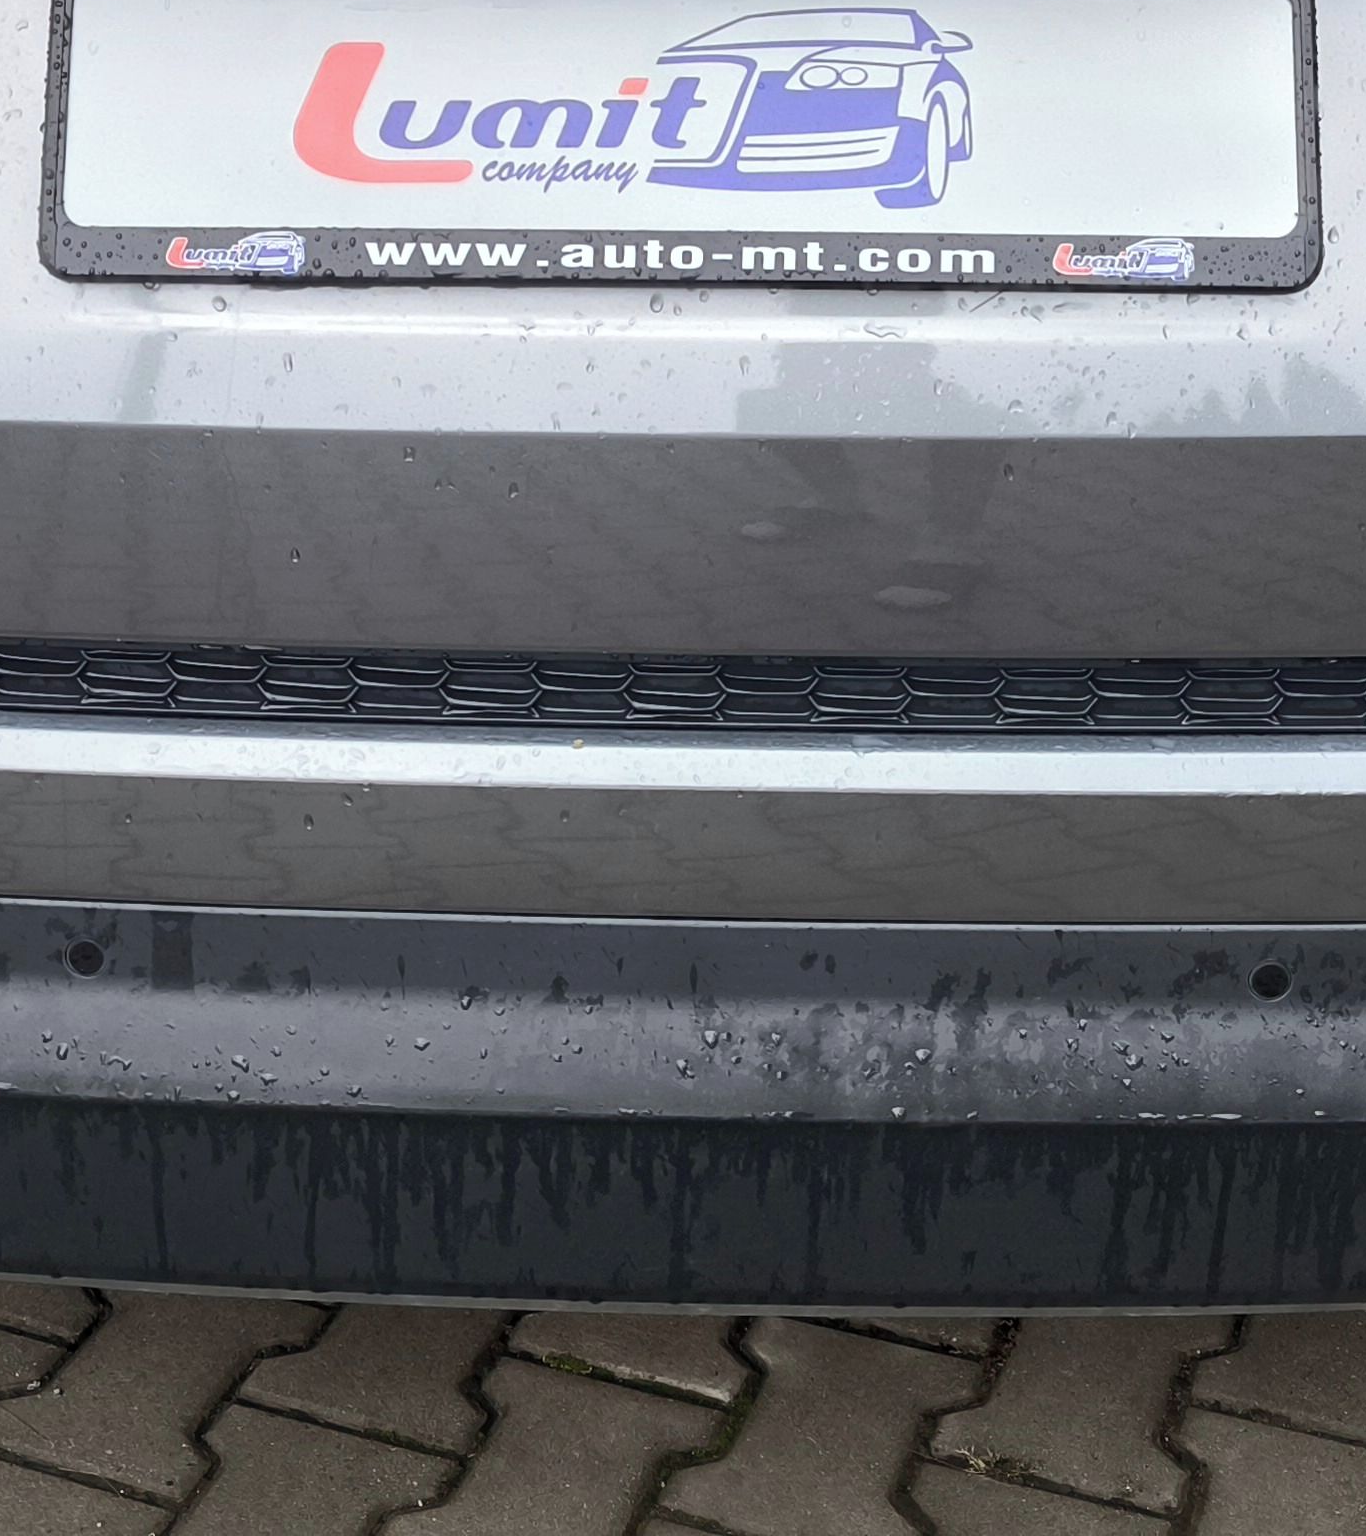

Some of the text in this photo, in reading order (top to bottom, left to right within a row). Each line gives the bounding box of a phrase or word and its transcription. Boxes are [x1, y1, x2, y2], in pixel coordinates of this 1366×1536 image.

[293, 41, 707, 184] Lumit
[482, 154, 640, 194] company
[364, 239, 996, 274] www.auto-mt.com
